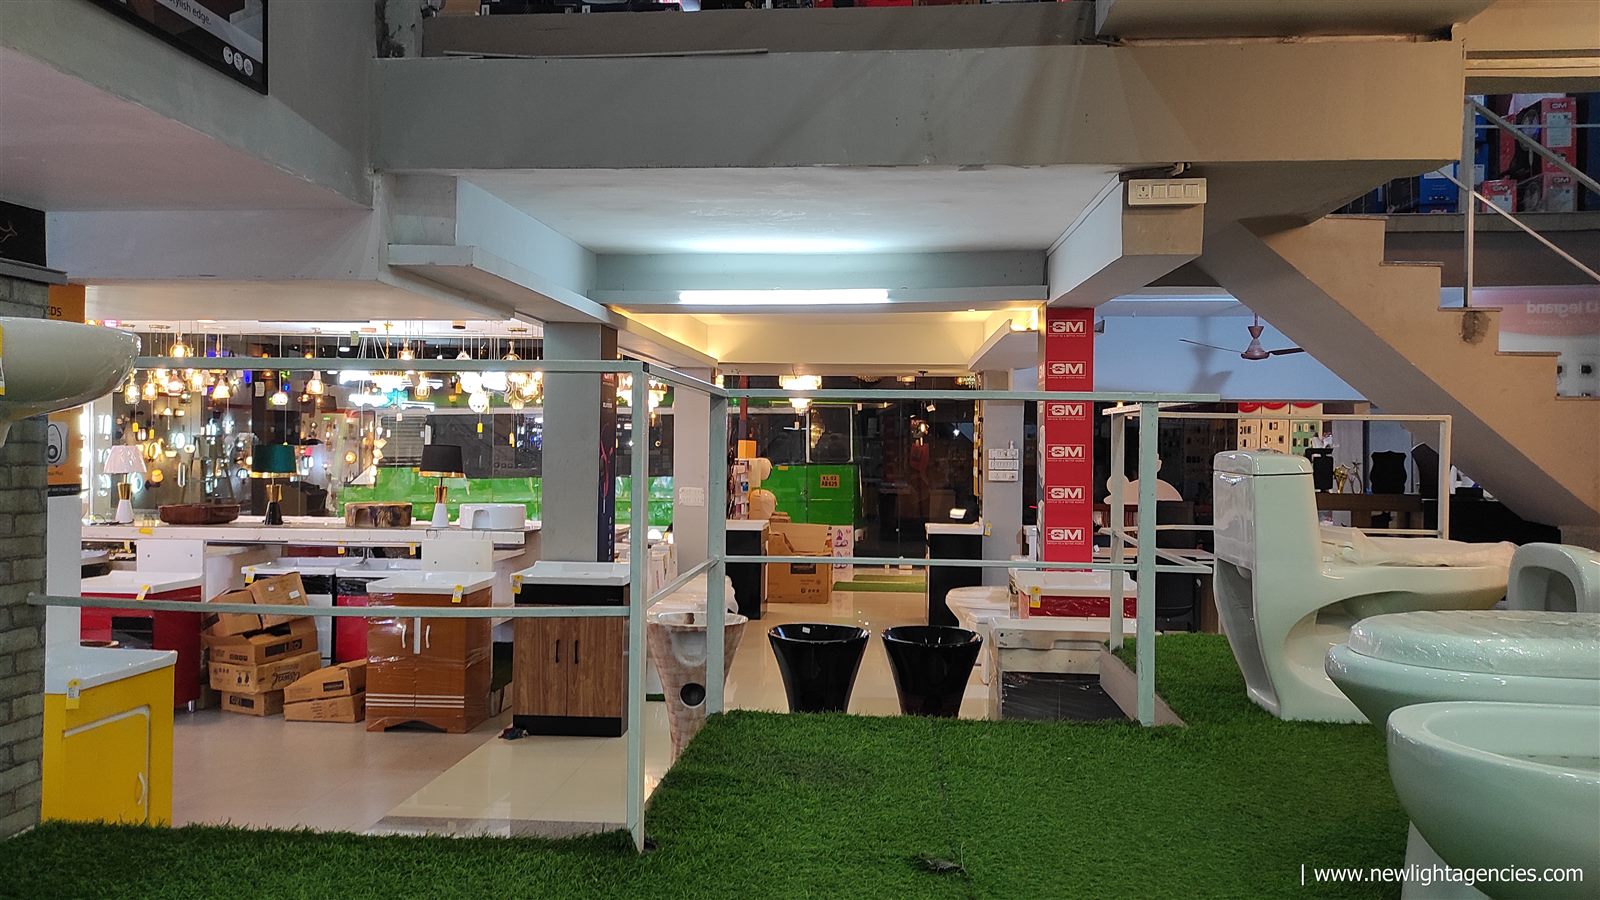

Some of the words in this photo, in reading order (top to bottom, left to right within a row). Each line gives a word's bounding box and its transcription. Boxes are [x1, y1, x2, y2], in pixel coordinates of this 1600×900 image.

[170, 0, 191, 12] ylish
[1049, 321, 1084, 333] GM
[1049, 363, 1084, 375] GM
[1048, 404, 1083, 416] GM
[1048, 446, 1083, 458] GM
[1048, 487, 1082, 499] GM
[1047, 529, 1082, 541] GM
